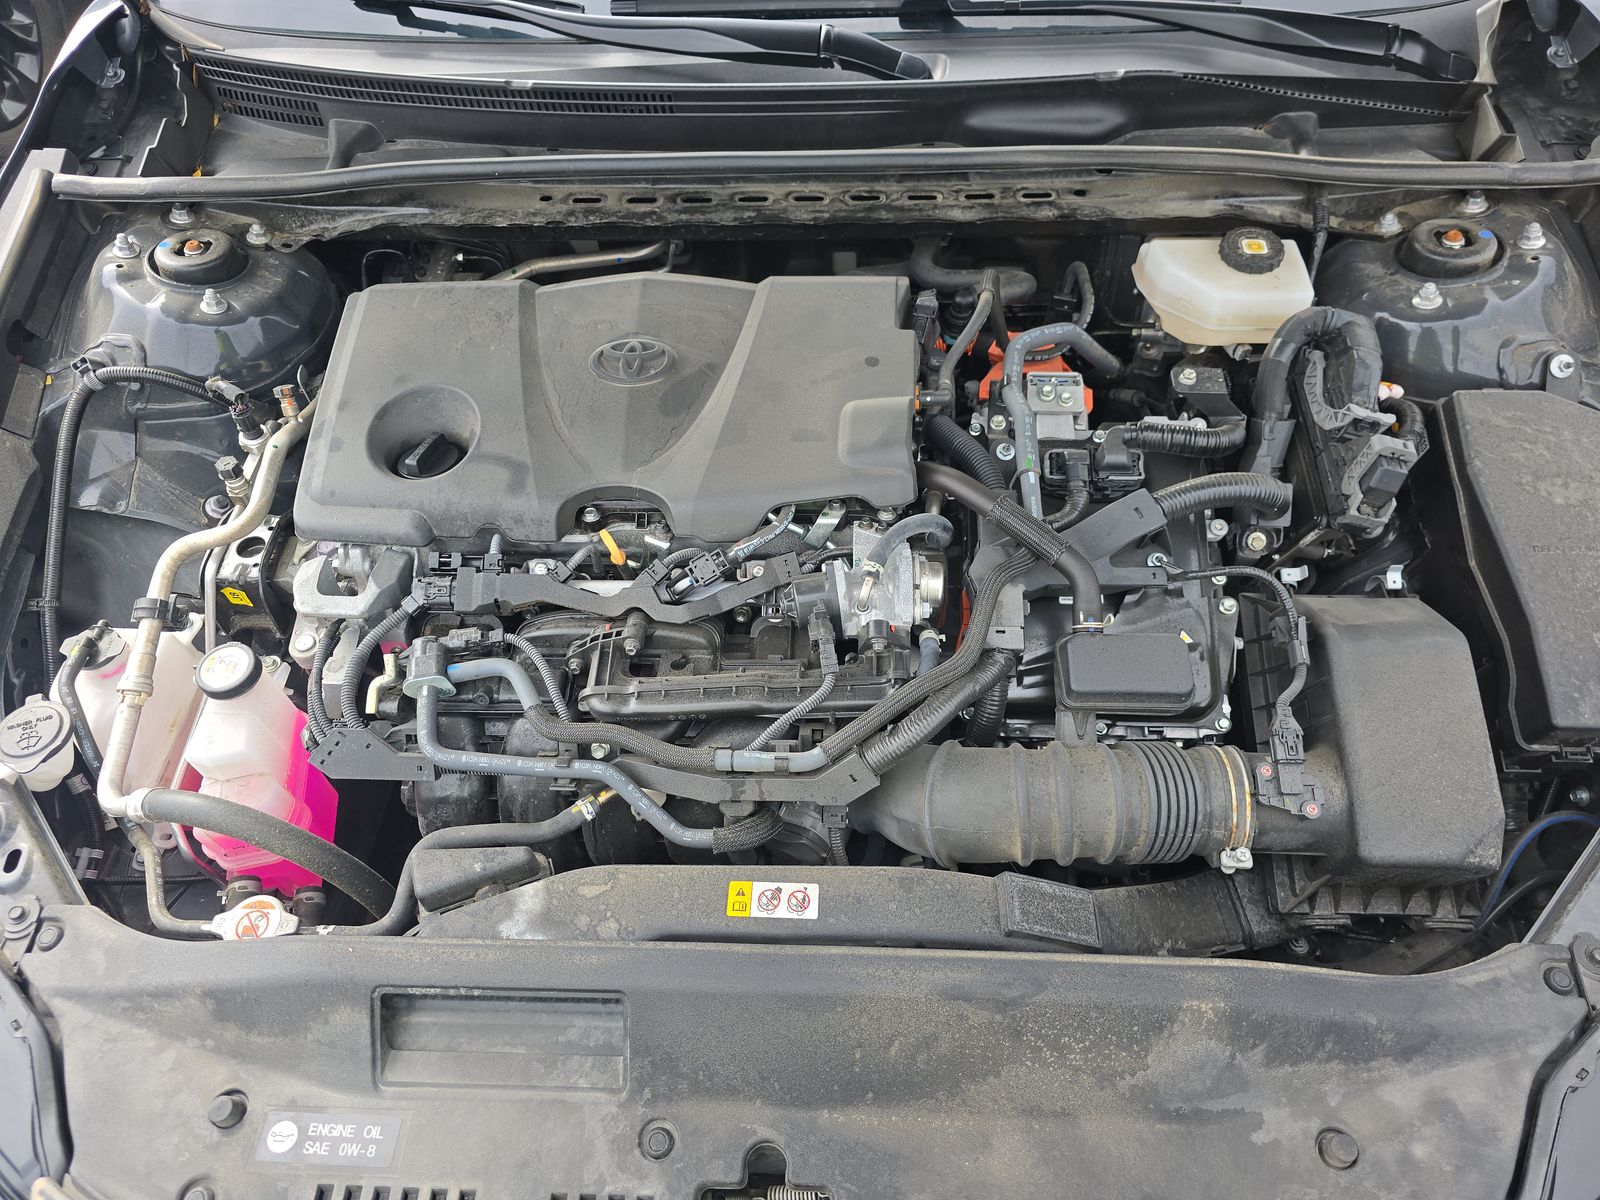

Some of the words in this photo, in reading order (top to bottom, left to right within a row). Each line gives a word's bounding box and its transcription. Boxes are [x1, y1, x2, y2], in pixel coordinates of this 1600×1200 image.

[307, 1122, 357, 1138] ENGINE
[363, 1125, 384, 1140] OIL
[303, 1140, 331, 1156] SAE
[339, 1142, 377, 1158] 0W-8
